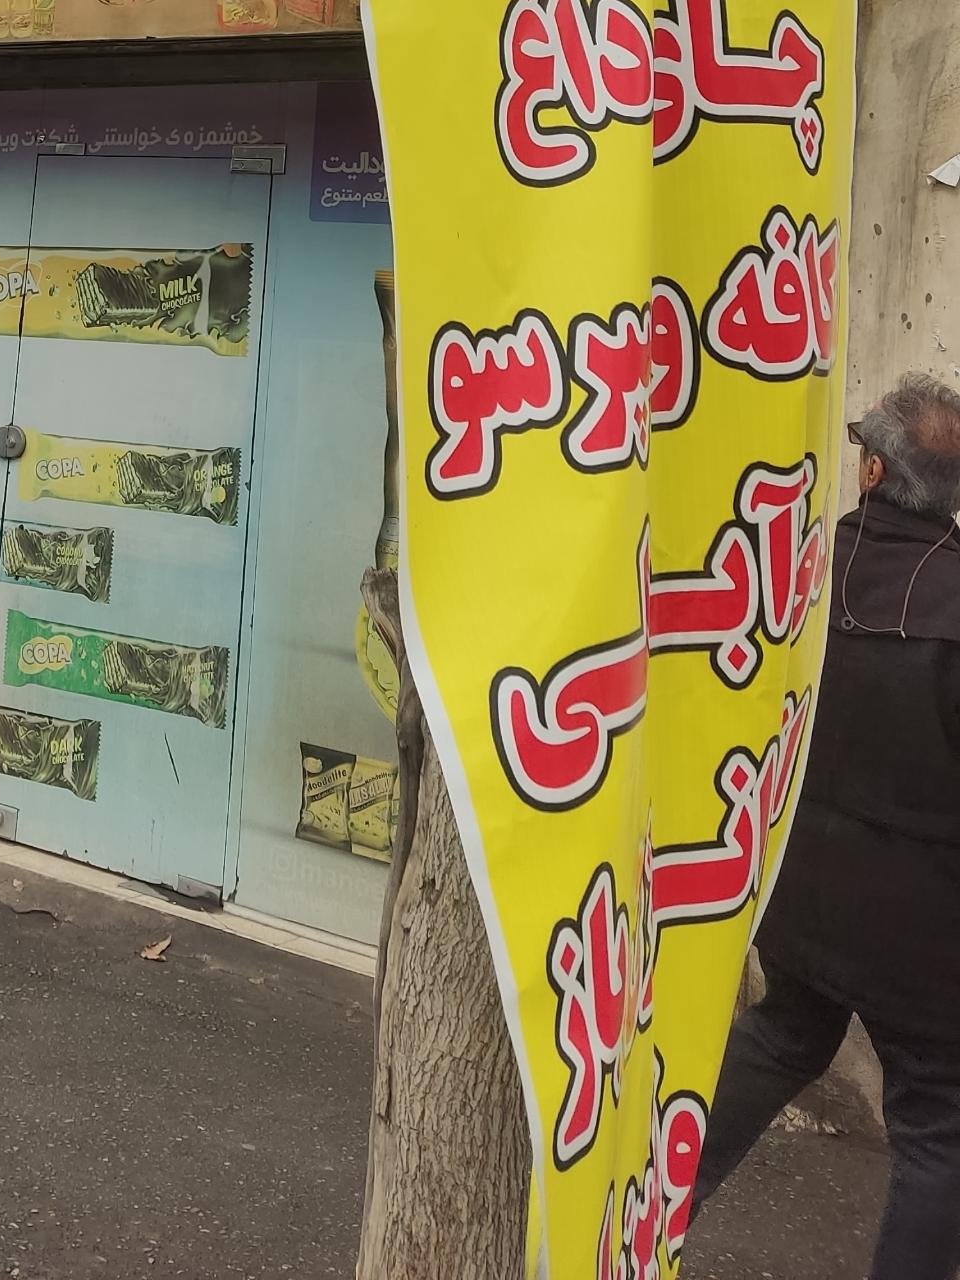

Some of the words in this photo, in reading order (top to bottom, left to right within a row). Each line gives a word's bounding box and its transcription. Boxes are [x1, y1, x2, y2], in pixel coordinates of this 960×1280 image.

[89, 123, 163, 153] خواستنی
[320, 187, 362, 208] متنوع
[159, 273, 199, 302] MILK
[700, 204, 840, 382] کافه
[161, 292, 201, 311] CHOCOLATE
[35, 457, 84, 481] COPA
[194, 462, 234, 482] ORNGE
[20, 641, 71, 665] COPA
[50, 735, 83, 756] DARK
